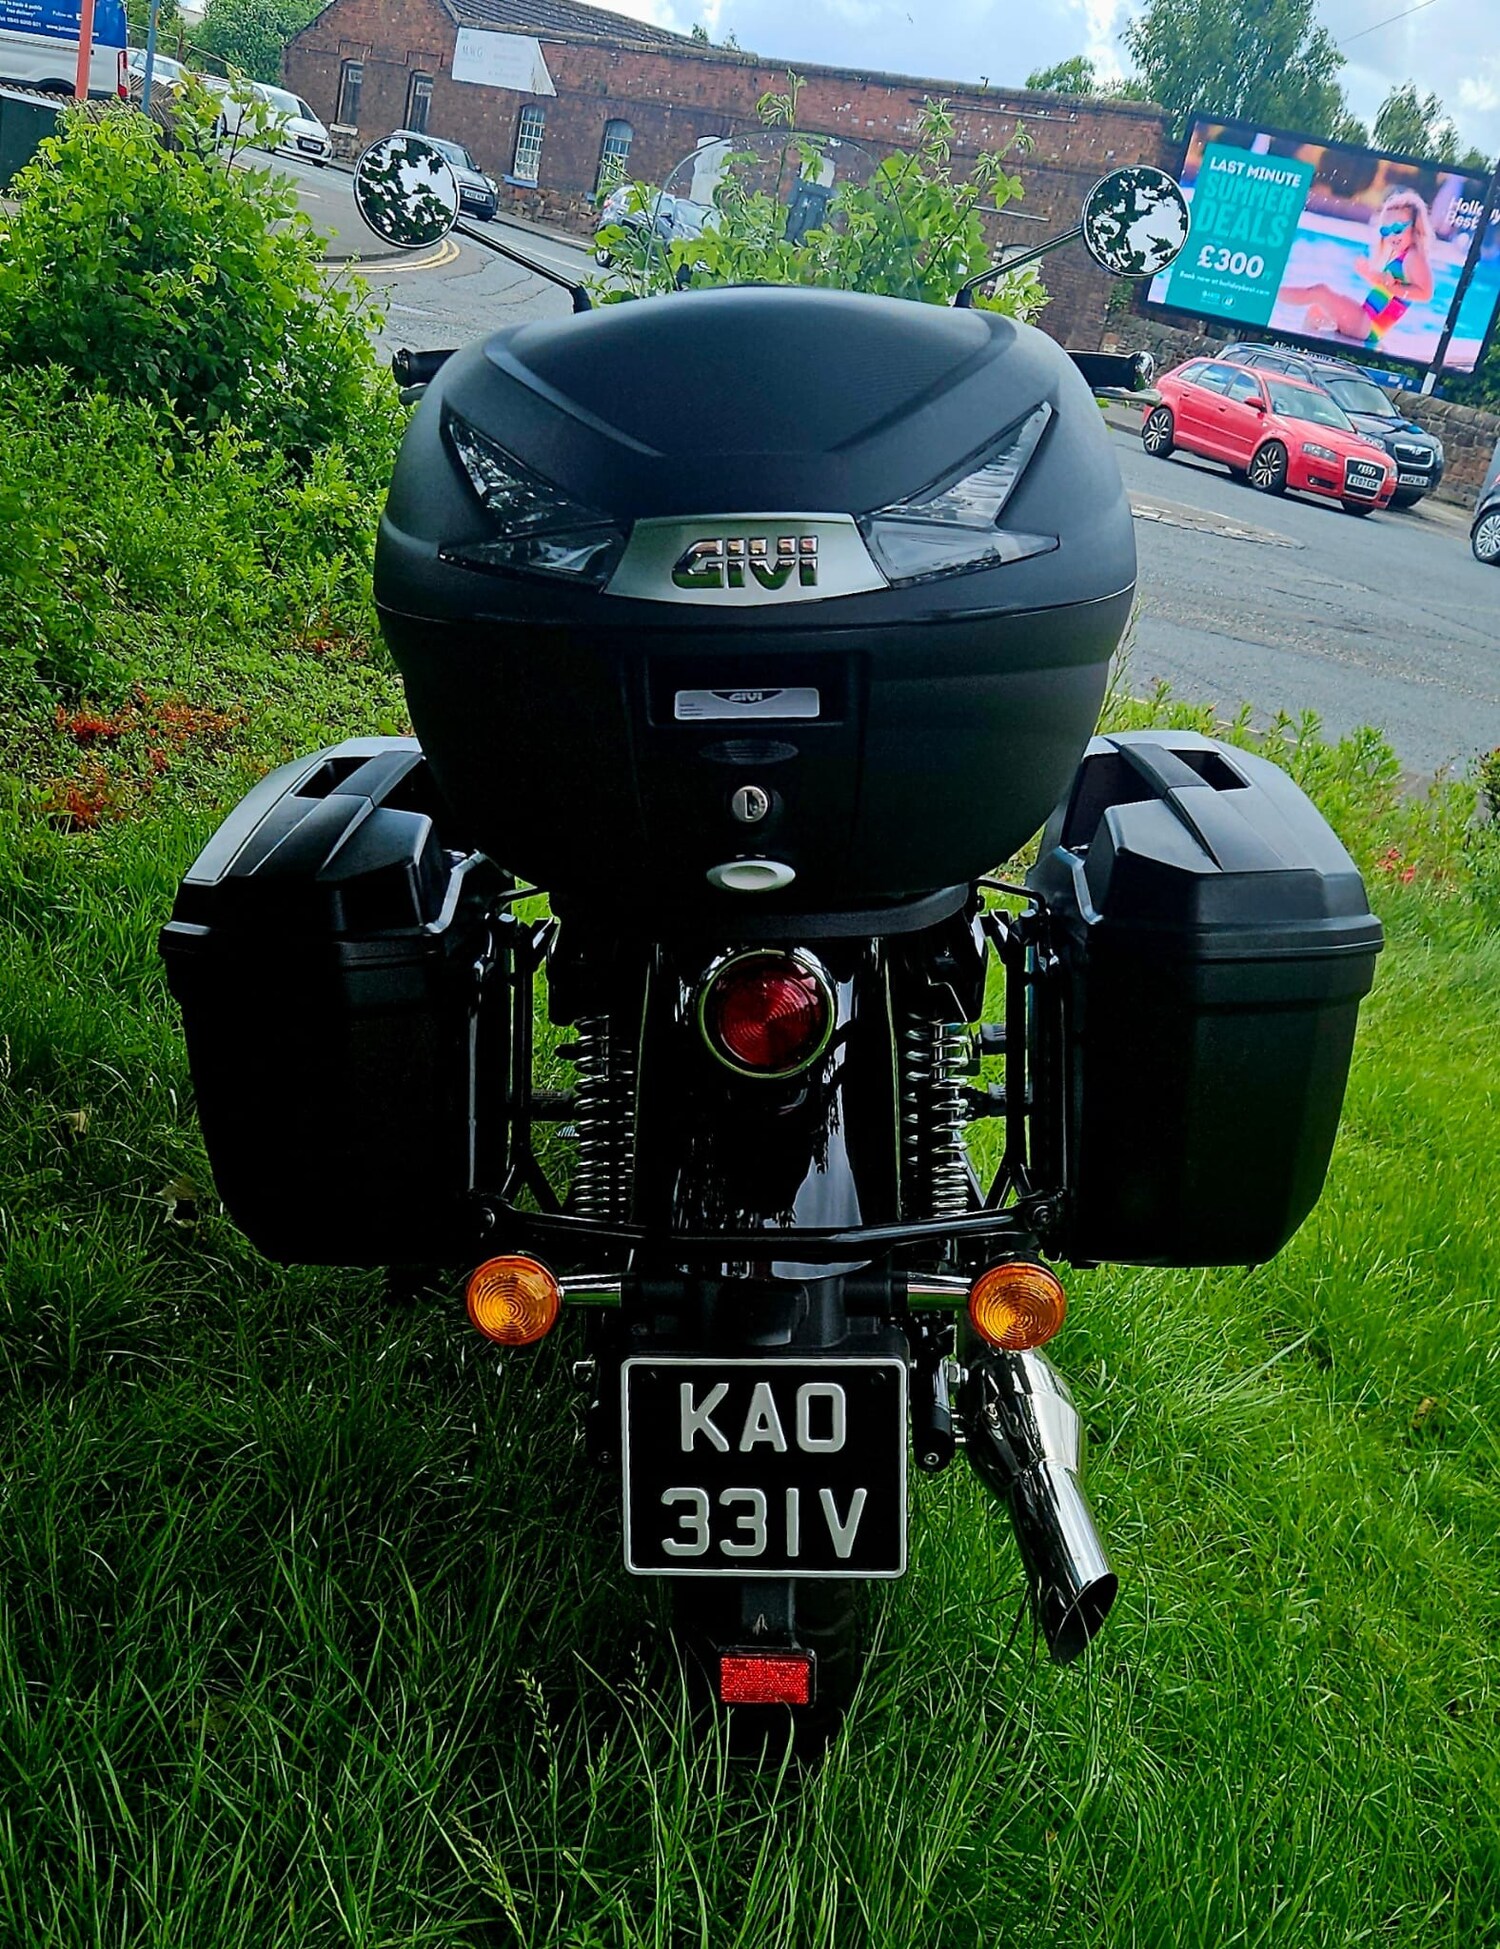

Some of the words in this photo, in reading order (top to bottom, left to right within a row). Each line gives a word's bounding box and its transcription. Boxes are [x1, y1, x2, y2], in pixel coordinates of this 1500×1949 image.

[1209, 156, 1246, 176] LAST
[1246, 165, 1302, 188] MINUTE
[1203, 172, 1297, 215] SUMMER
[1194, 198, 1289, 247] DEALS
[1444, 210, 1480, 231] Best
[1179, 270, 1196, 281] Book
[1197, 275, 1211, 283] now
[1211, 278, 1219, 286] at
[1197, 244, 1265, 279] £300
[671, 534, 819, 591] GIVI
[729, 691, 763, 702] GIVI
[680, 1381, 847, 1454] KAO
[660, 1486, 868, 1559] 331V
